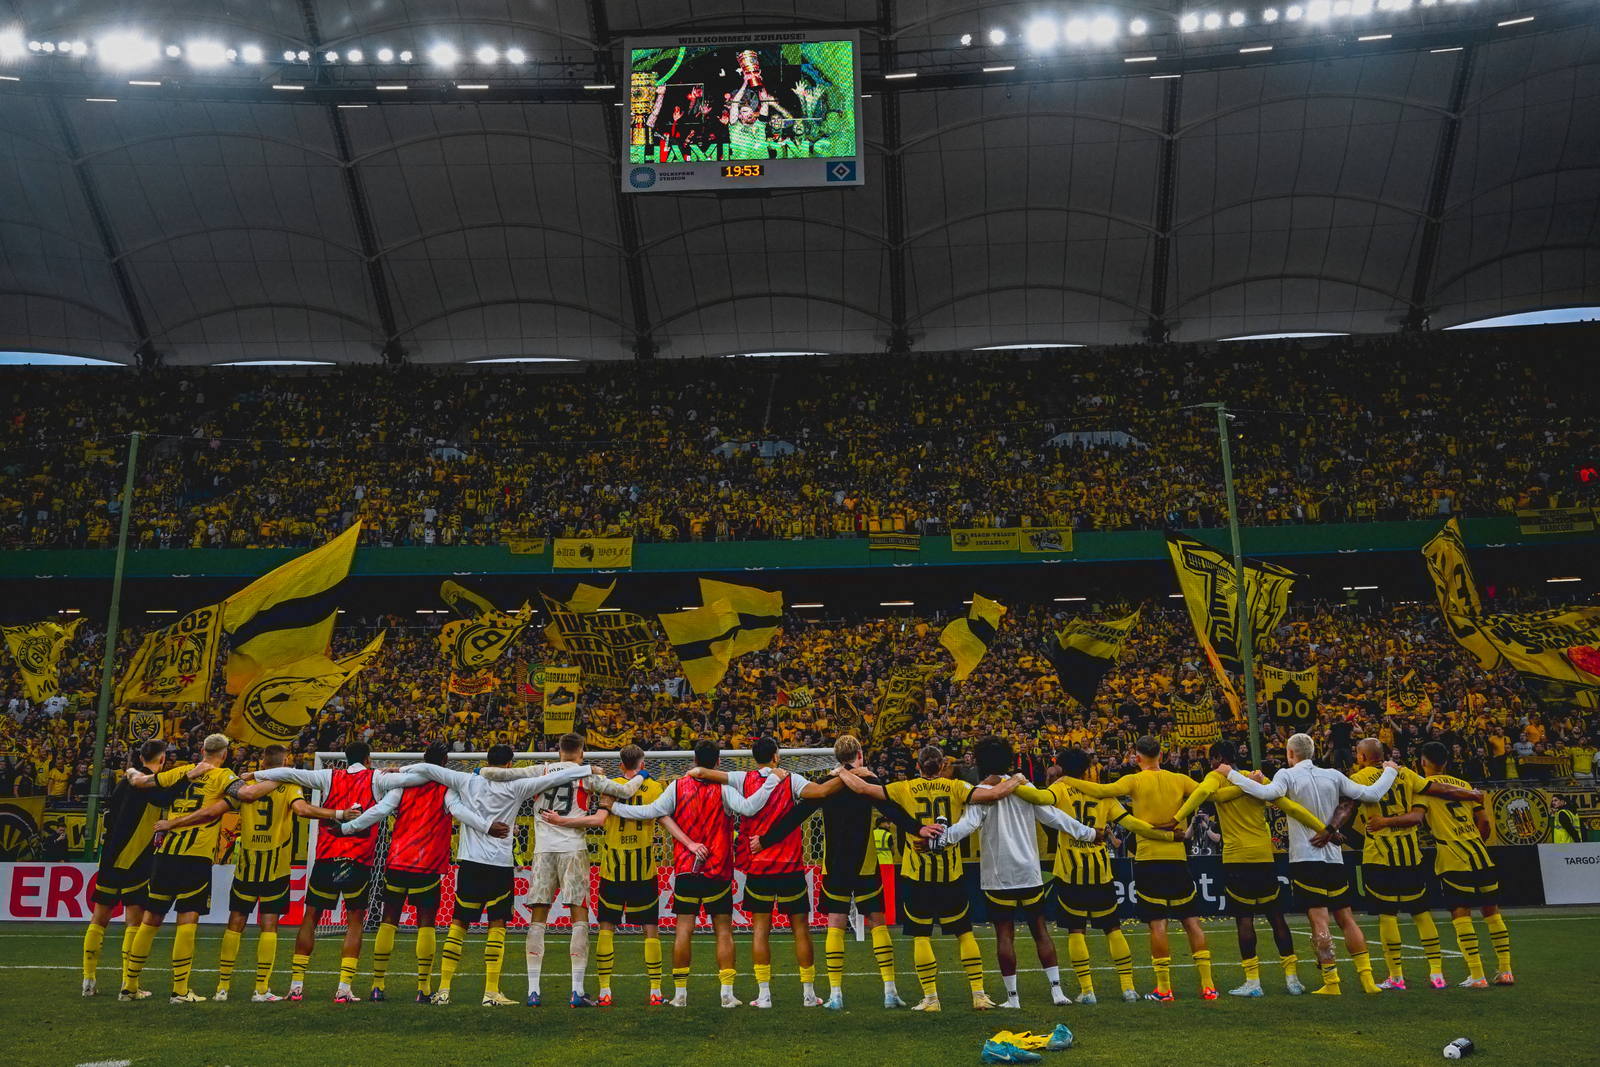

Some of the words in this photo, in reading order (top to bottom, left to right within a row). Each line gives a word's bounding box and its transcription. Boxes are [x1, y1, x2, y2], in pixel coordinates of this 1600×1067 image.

[678, 35, 752, 44] WILLKOMMEN
[753, 33, 806, 42] ZUHAUSE!
[725, 165, 761, 178] 19:53
[1263, 669, 1283, 680] THE
[1276, 698, 1310, 719] DO
[911, 782, 951, 794] DORTMUND
[254, 796, 273, 831] 3
[251, 835, 272, 843] ANTON
[620, 835, 638, 844] BEIER
